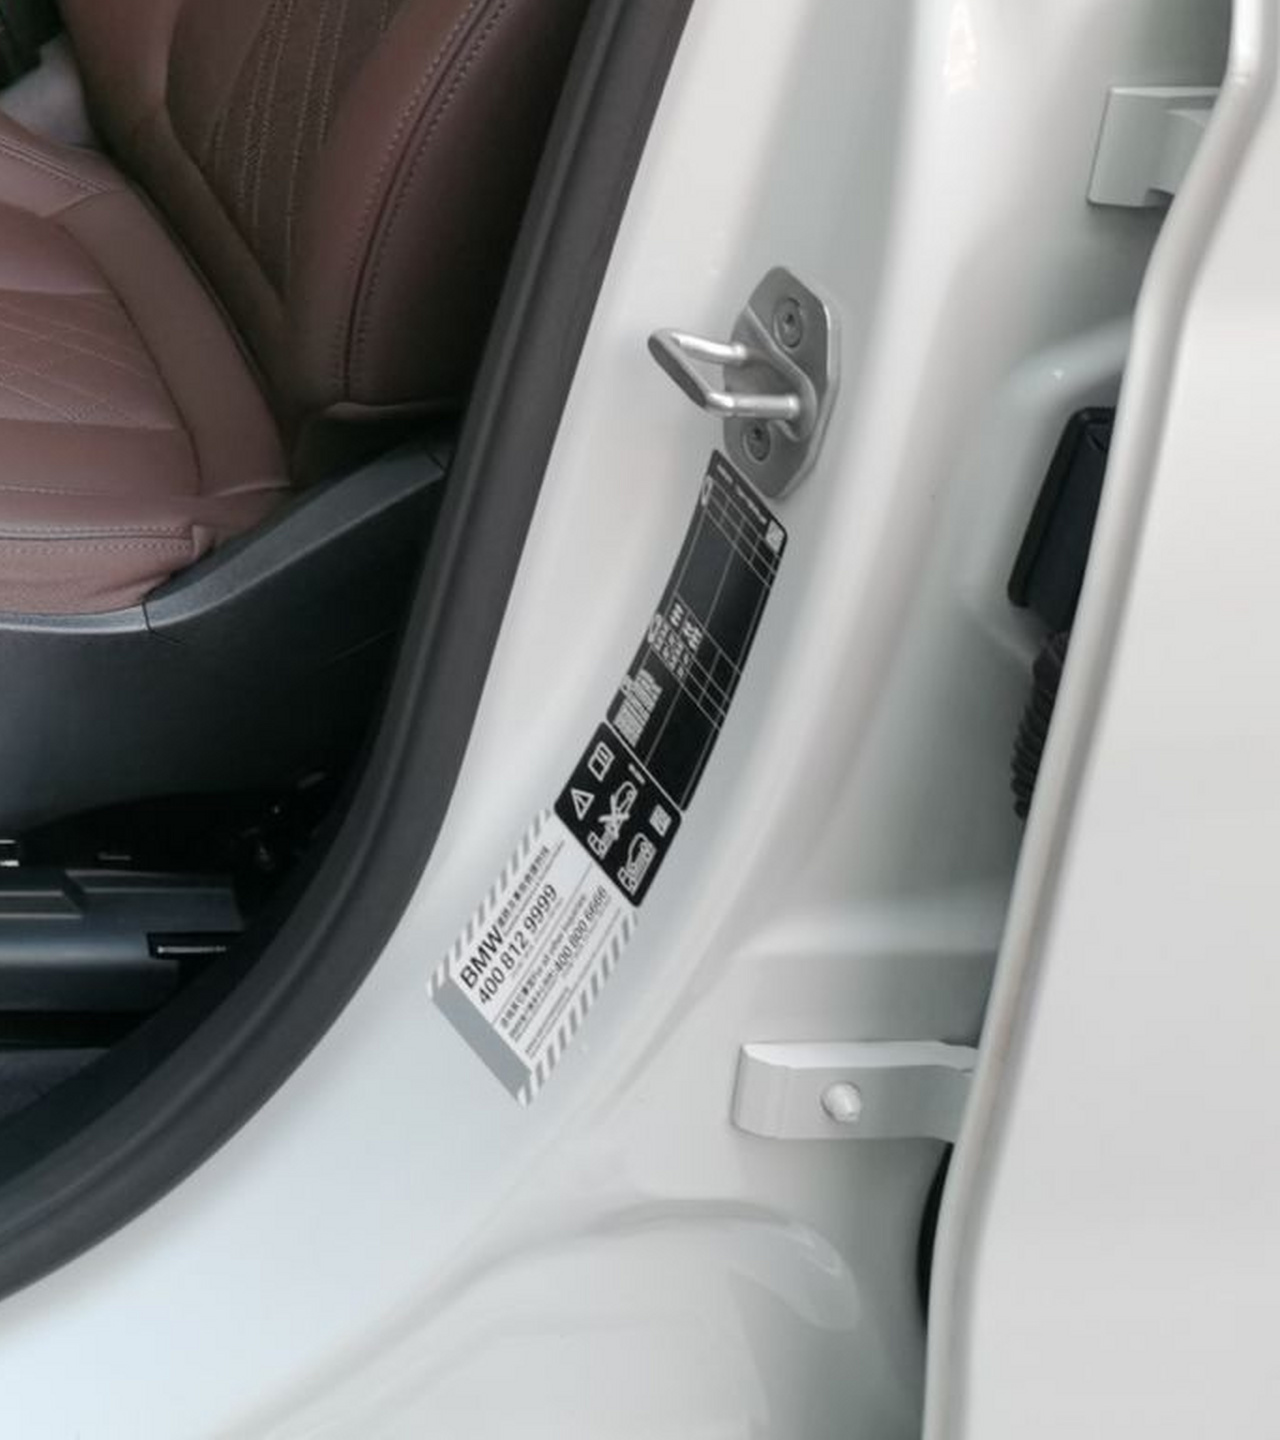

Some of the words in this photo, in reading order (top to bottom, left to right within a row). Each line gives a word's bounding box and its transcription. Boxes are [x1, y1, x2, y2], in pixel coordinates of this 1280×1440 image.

[458, 922, 505, 990] BMW
[475, 963, 506, 1008] 400
[498, 927, 529, 972] 812
[520, 880, 559, 935] 9999
